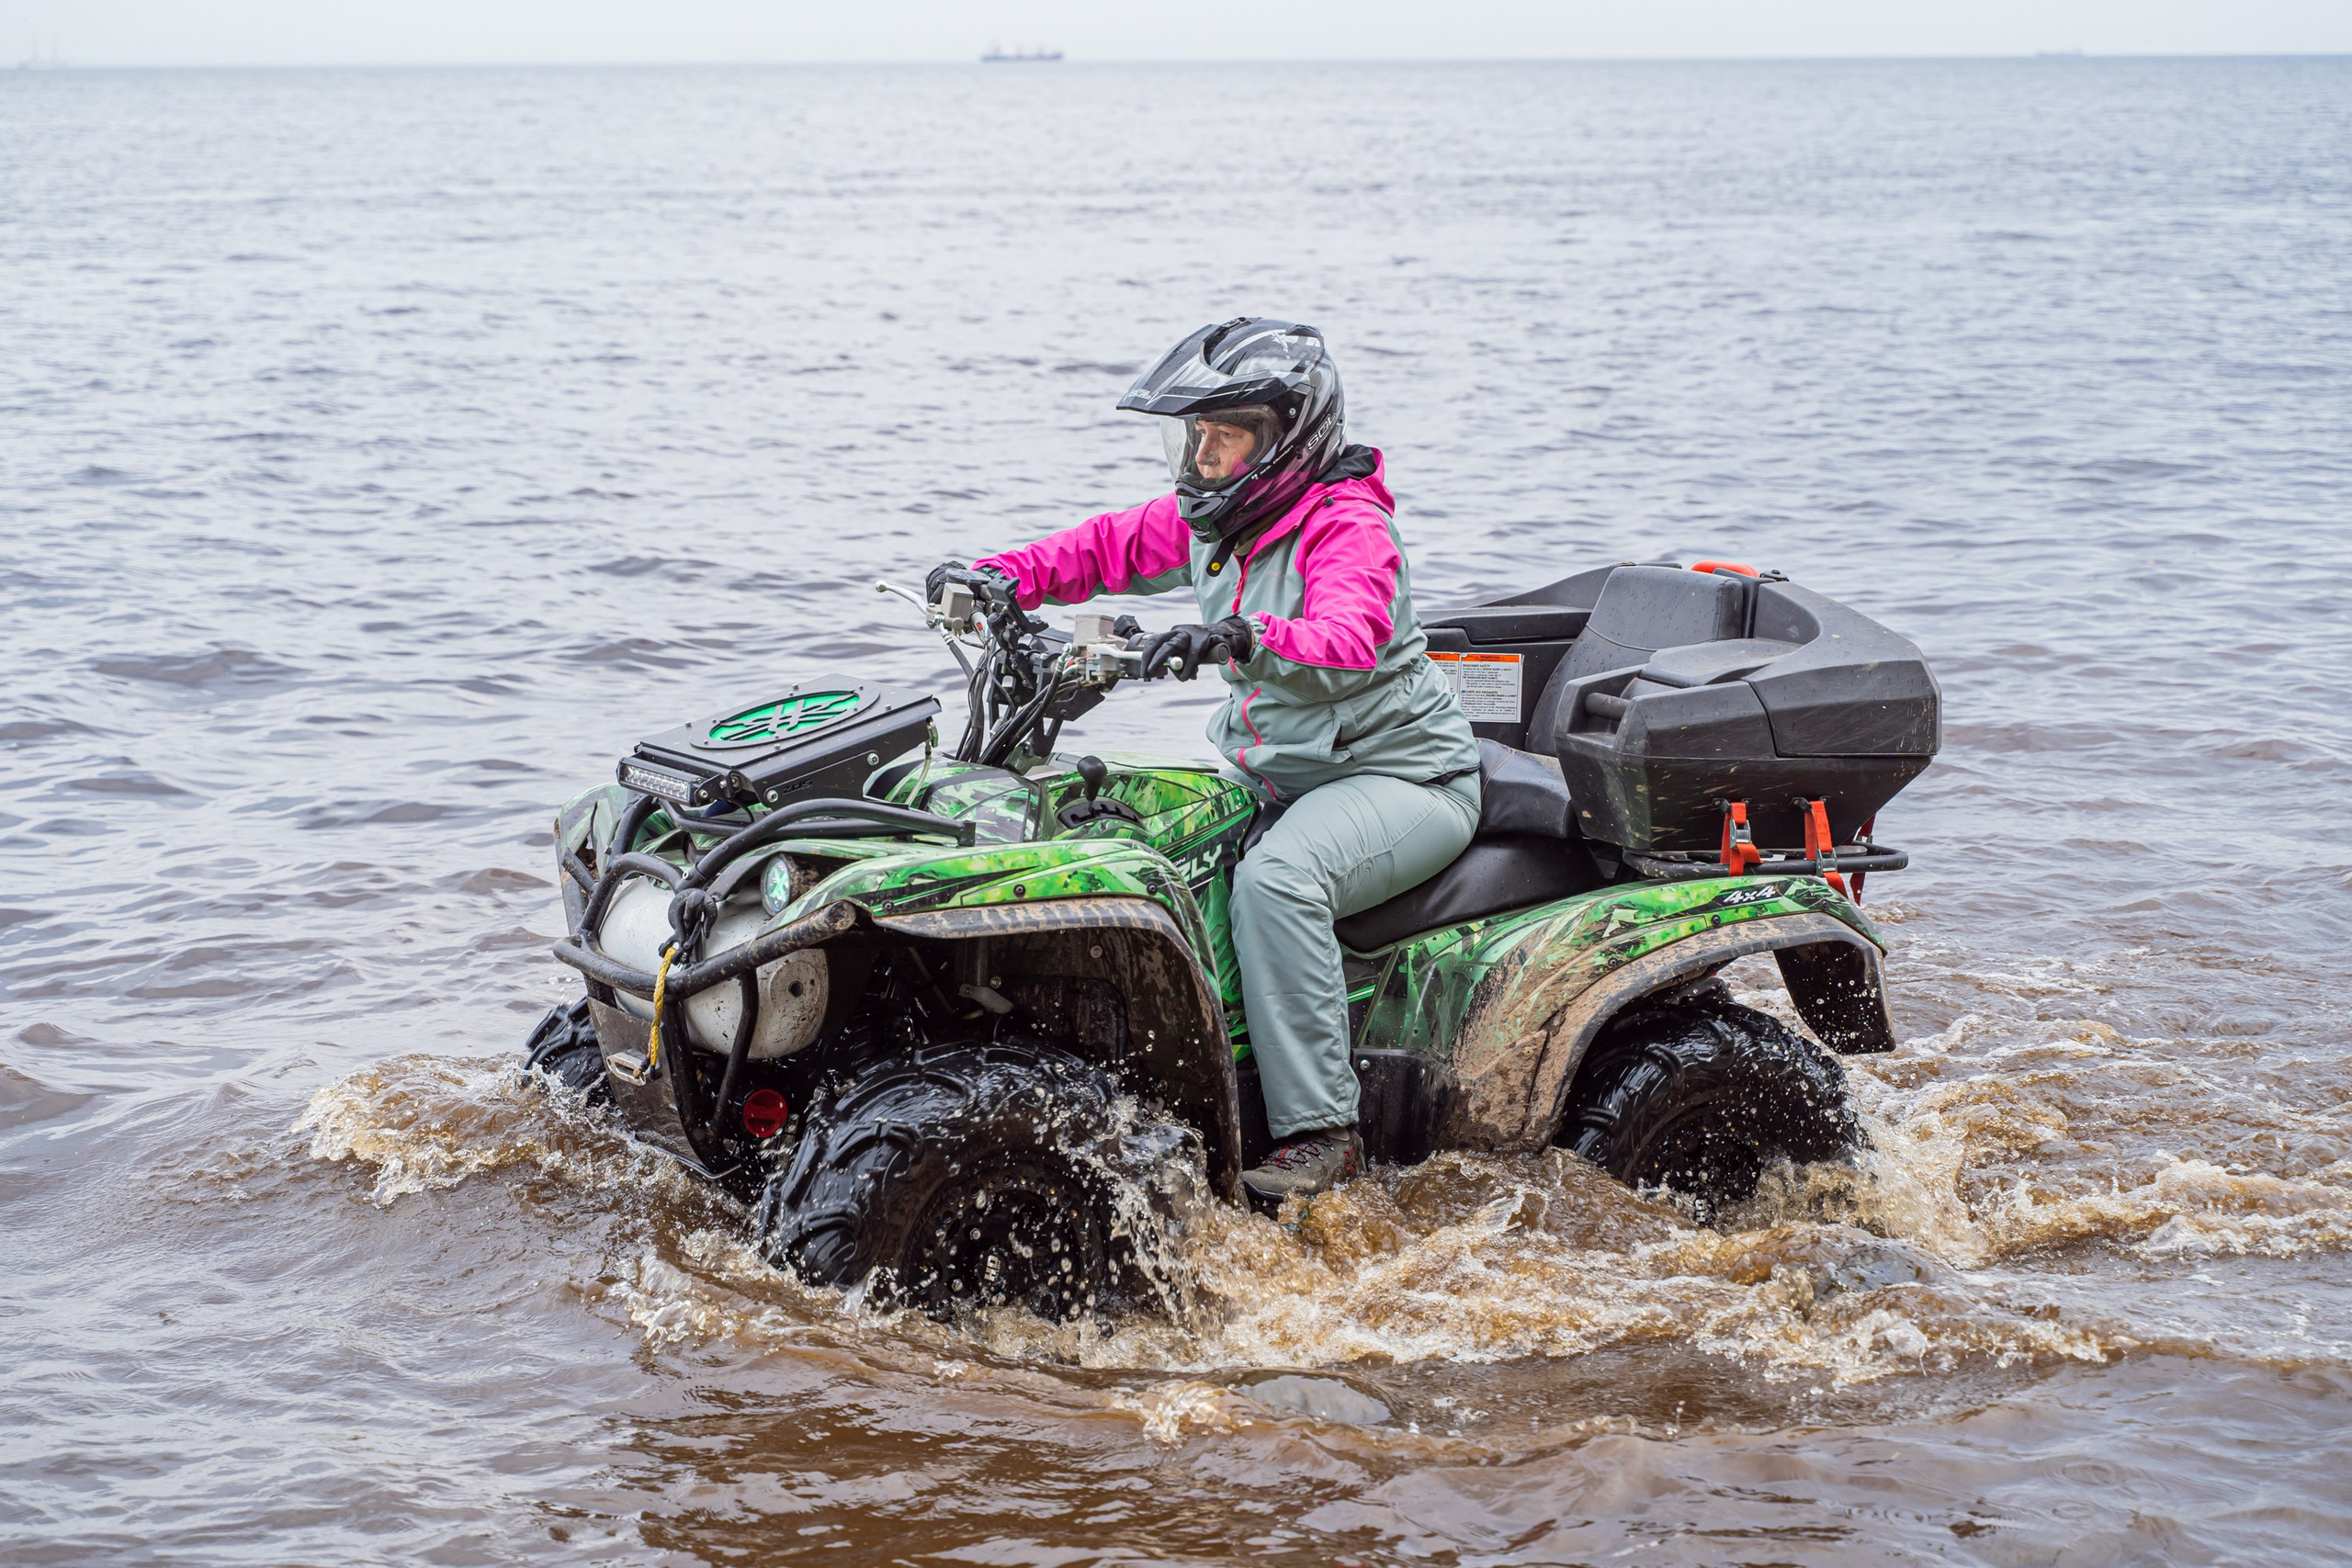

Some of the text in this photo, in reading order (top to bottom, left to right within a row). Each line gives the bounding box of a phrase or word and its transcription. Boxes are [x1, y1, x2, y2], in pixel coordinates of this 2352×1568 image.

[1306, 413, 1337, 451] SOL
[1723, 885, 1776, 903] 4x4
[984, 1255, 999, 1281] HD
